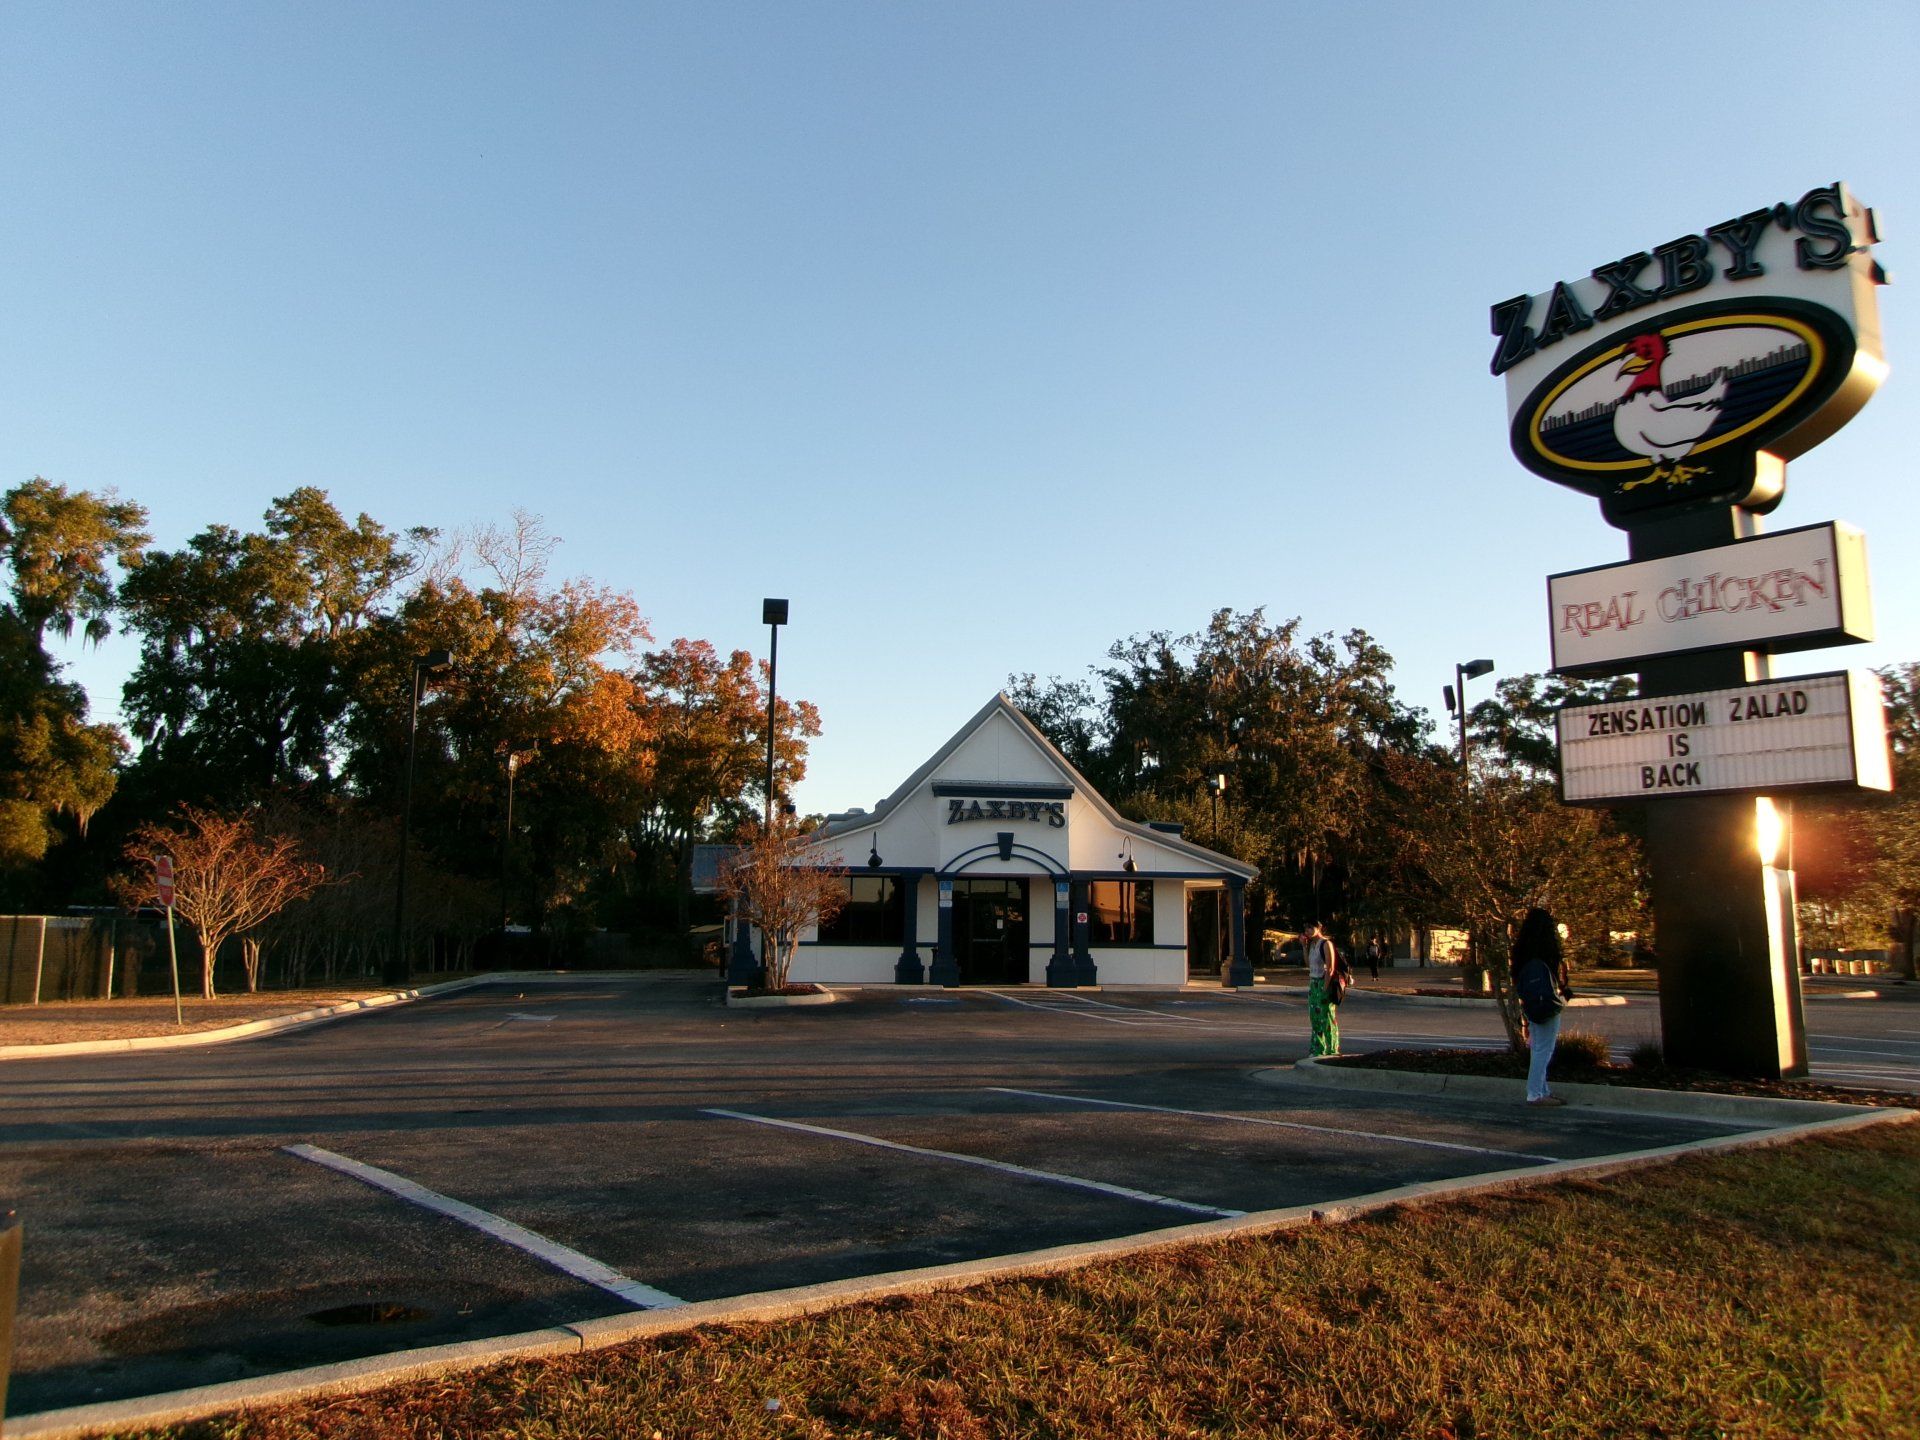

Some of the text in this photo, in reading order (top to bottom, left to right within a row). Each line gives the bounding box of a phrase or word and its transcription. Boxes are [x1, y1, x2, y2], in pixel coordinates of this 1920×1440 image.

[1490, 181, 1853, 376] ZAXBY'S
[1560, 558, 1828, 637] REAL CHICKEN
[1588, 690, 1808, 735] ZENSATION ZALAD
[1667, 733, 1690, 757] IS
[1641, 762, 1701, 789] BACK
[948, 800, 1065, 828] ZAXBY'S
